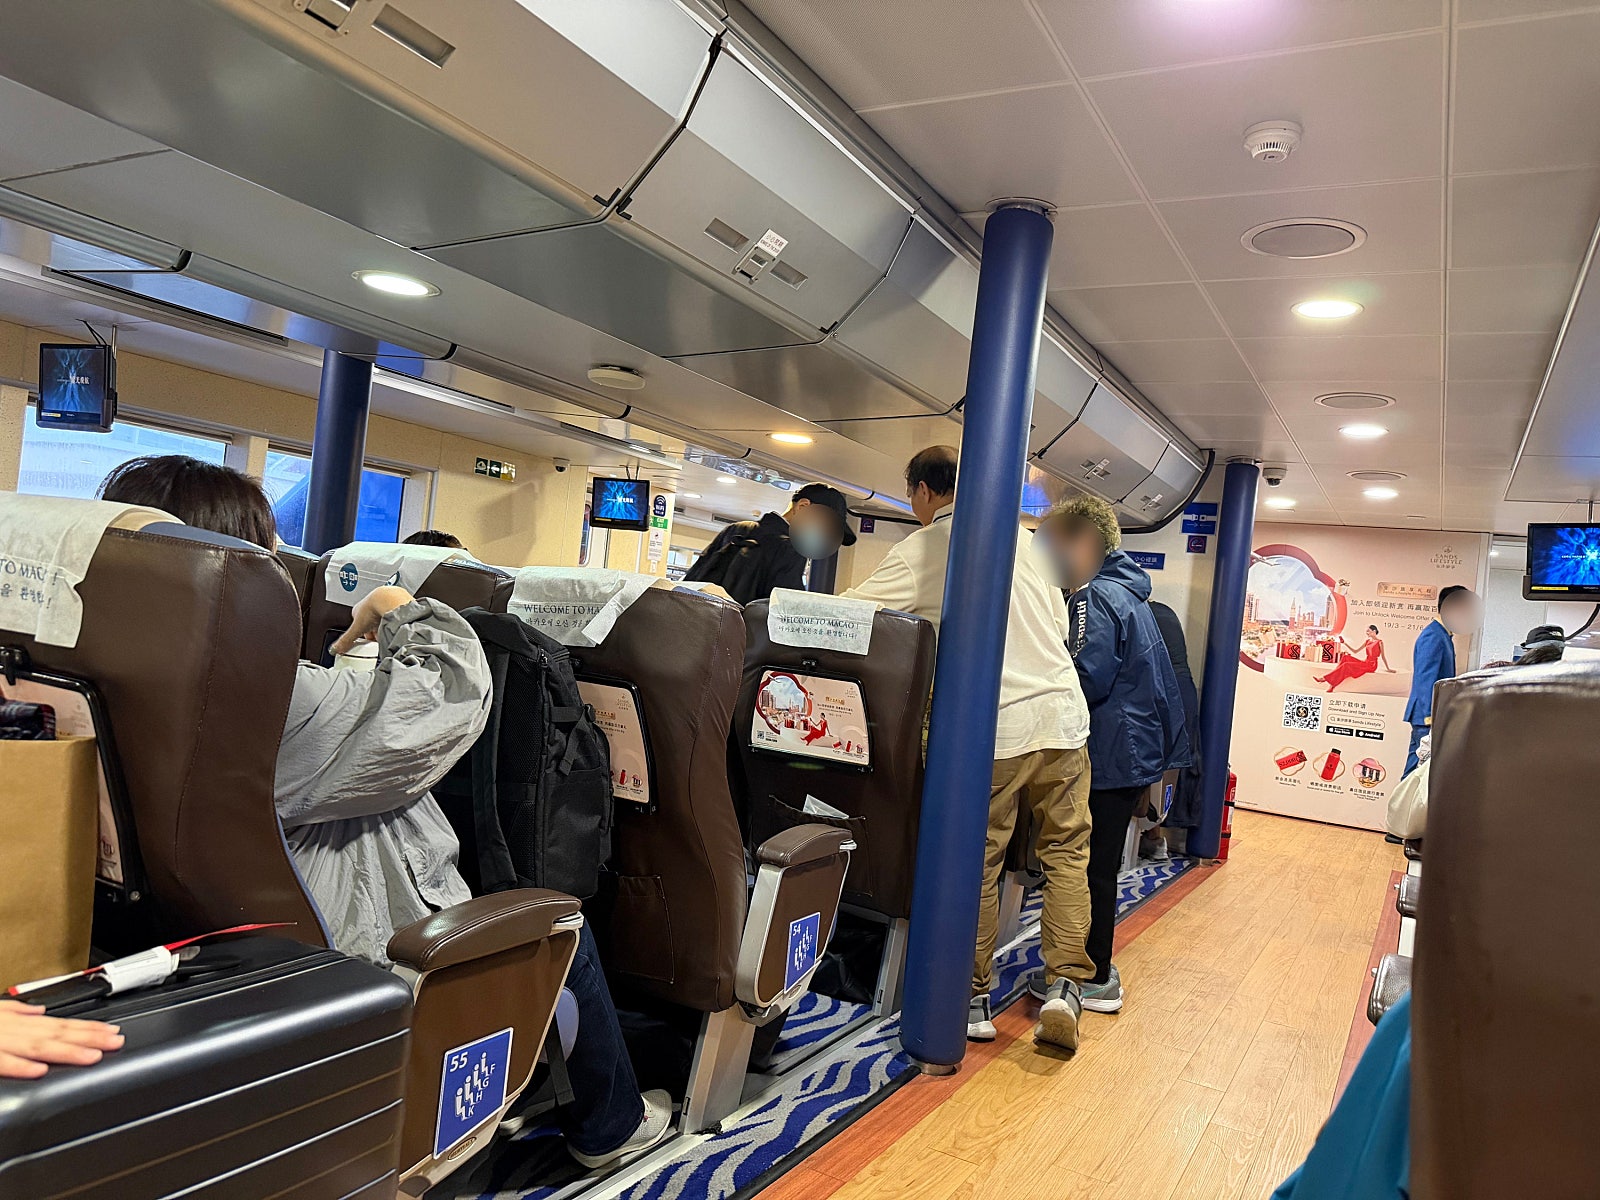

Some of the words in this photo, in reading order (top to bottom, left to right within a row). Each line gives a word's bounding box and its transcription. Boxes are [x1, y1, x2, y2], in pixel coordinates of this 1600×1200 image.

[20, 562, 48, 581] MAC
[524, 604, 570, 615] WELCOME
[572, 605, 585, 615] TO
[586, 606, 603, 616] MA
[777, 616, 813, 625] WELCOME
[828, 619, 854, 629] MACAO
[793, 924, 801, 936] 54
[450, 1052, 468, 1072] 55
[489, 1063, 496, 1075] F
[482, 1076, 489, 1088] G
[475, 1090, 483, 1102] H
[467, 1105, 475, 1117] K
